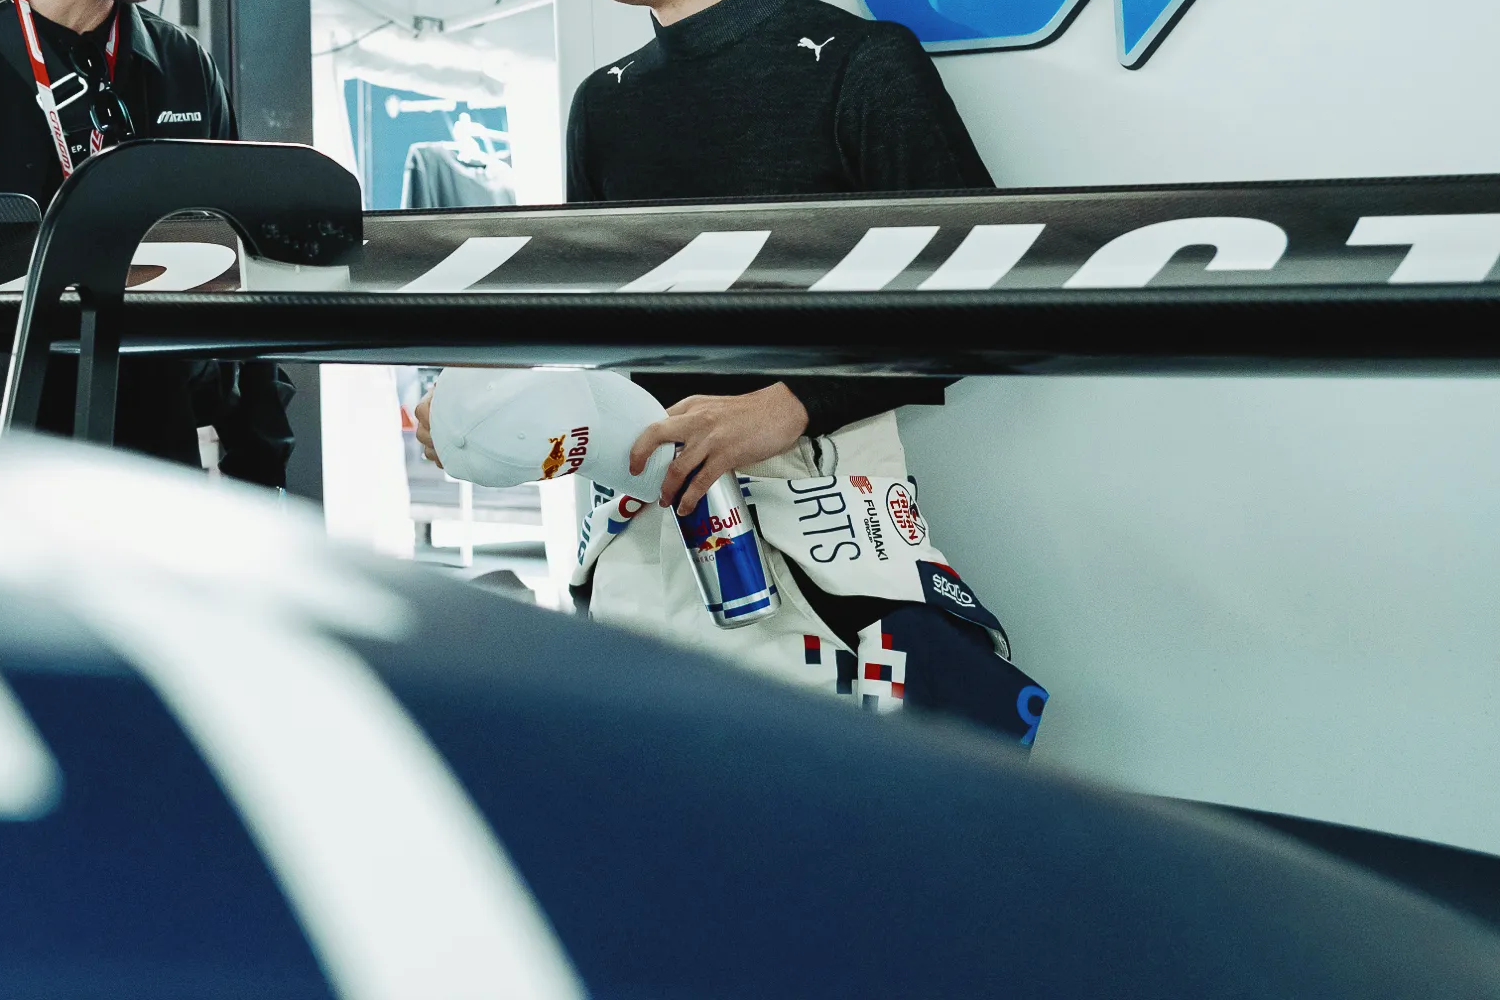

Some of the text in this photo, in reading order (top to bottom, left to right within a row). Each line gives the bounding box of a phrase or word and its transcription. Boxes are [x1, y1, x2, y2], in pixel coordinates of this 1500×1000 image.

[863, 499, 889, 561] FUJIMAKI
[889, 499, 907, 529] CUP
[896, 490, 919, 541] JAPAN
